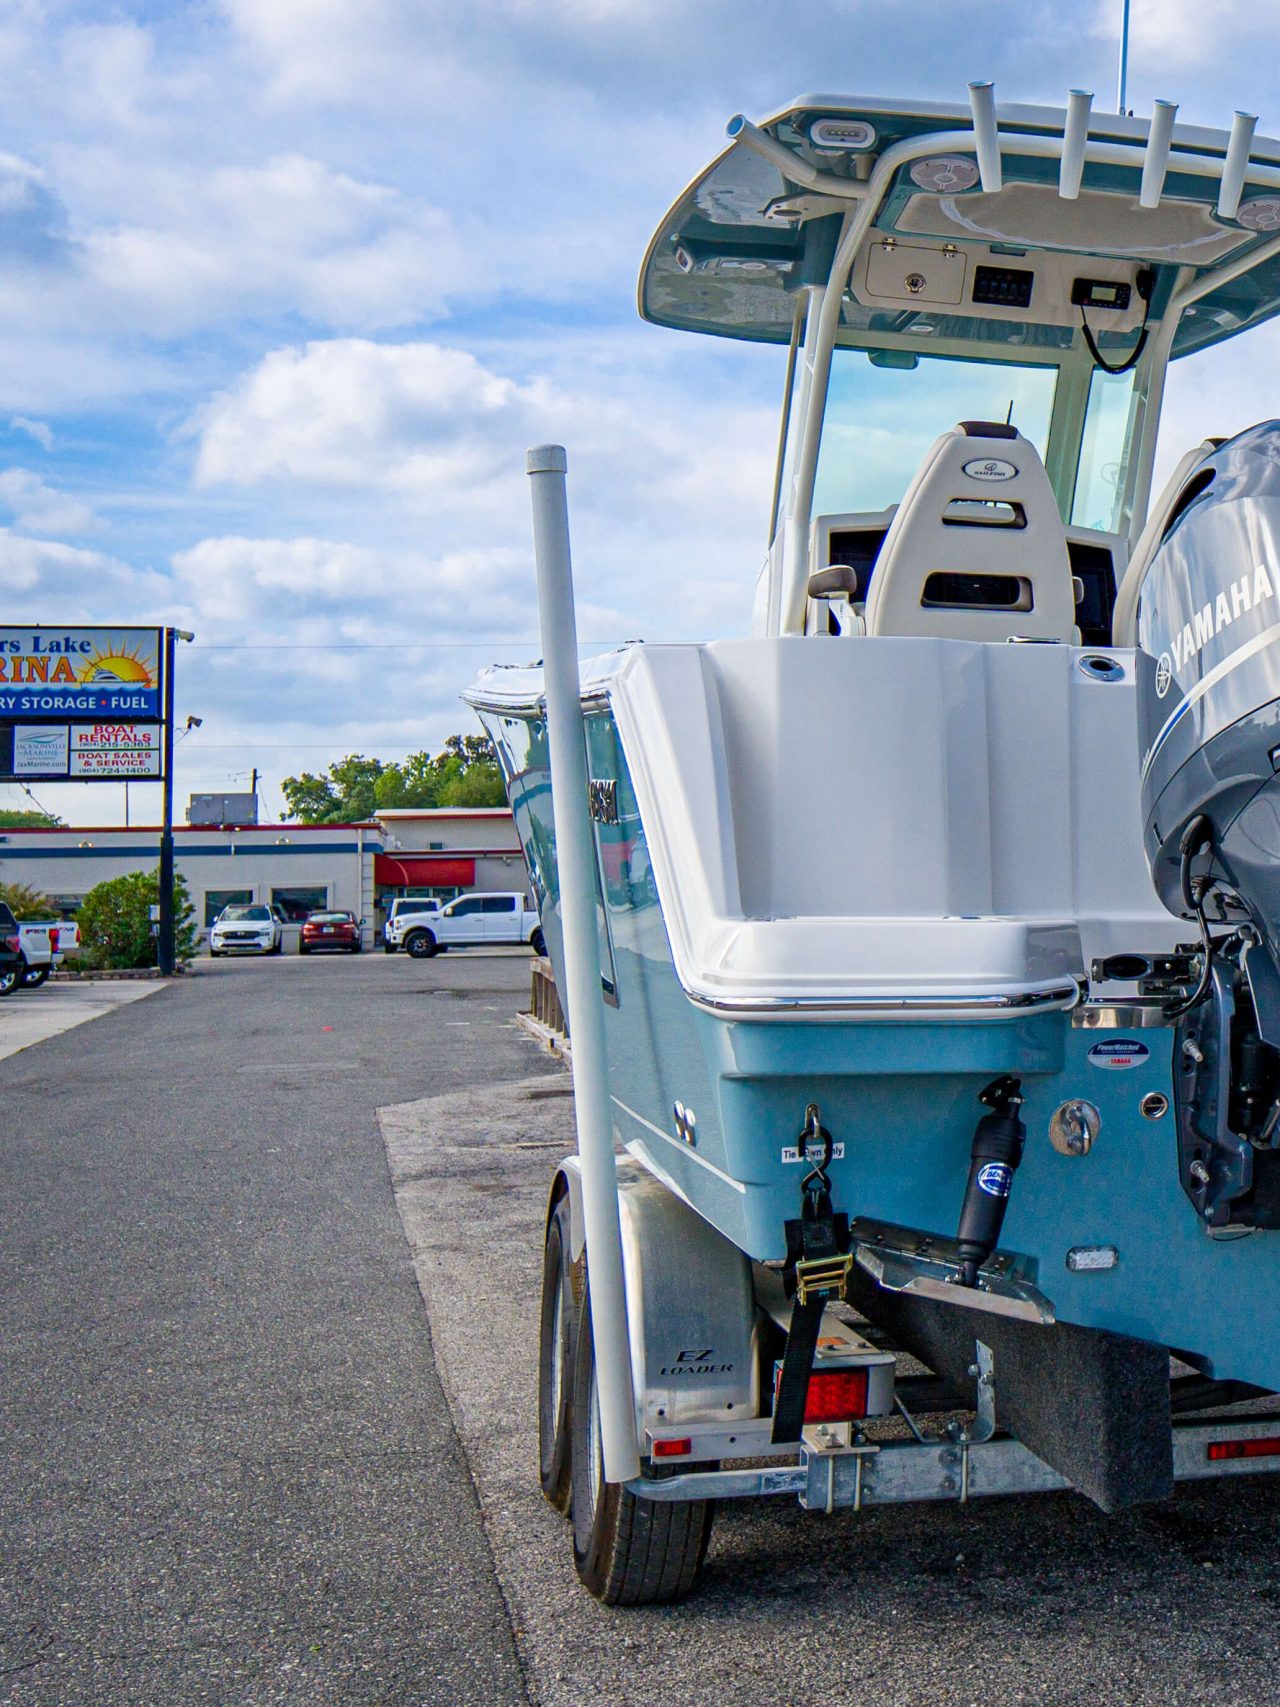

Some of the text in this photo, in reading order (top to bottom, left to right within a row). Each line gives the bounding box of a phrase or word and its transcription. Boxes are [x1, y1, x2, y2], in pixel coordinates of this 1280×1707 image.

[1170, 564, 1274, 673] YAMAHA
[32, 636, 91, 653] Lake
[21, 697, 96, 709] STORAGE
[111, 697, 148, 709] FUEL
[94, 725, 136, 734] BOAT
[79, 733, 152, 743] RENTALS
[783, 1150, 796, 1159] Tie
[677, 1349, 714, 1362] EZ
[660, 1364, 734, 1375] LOADER
